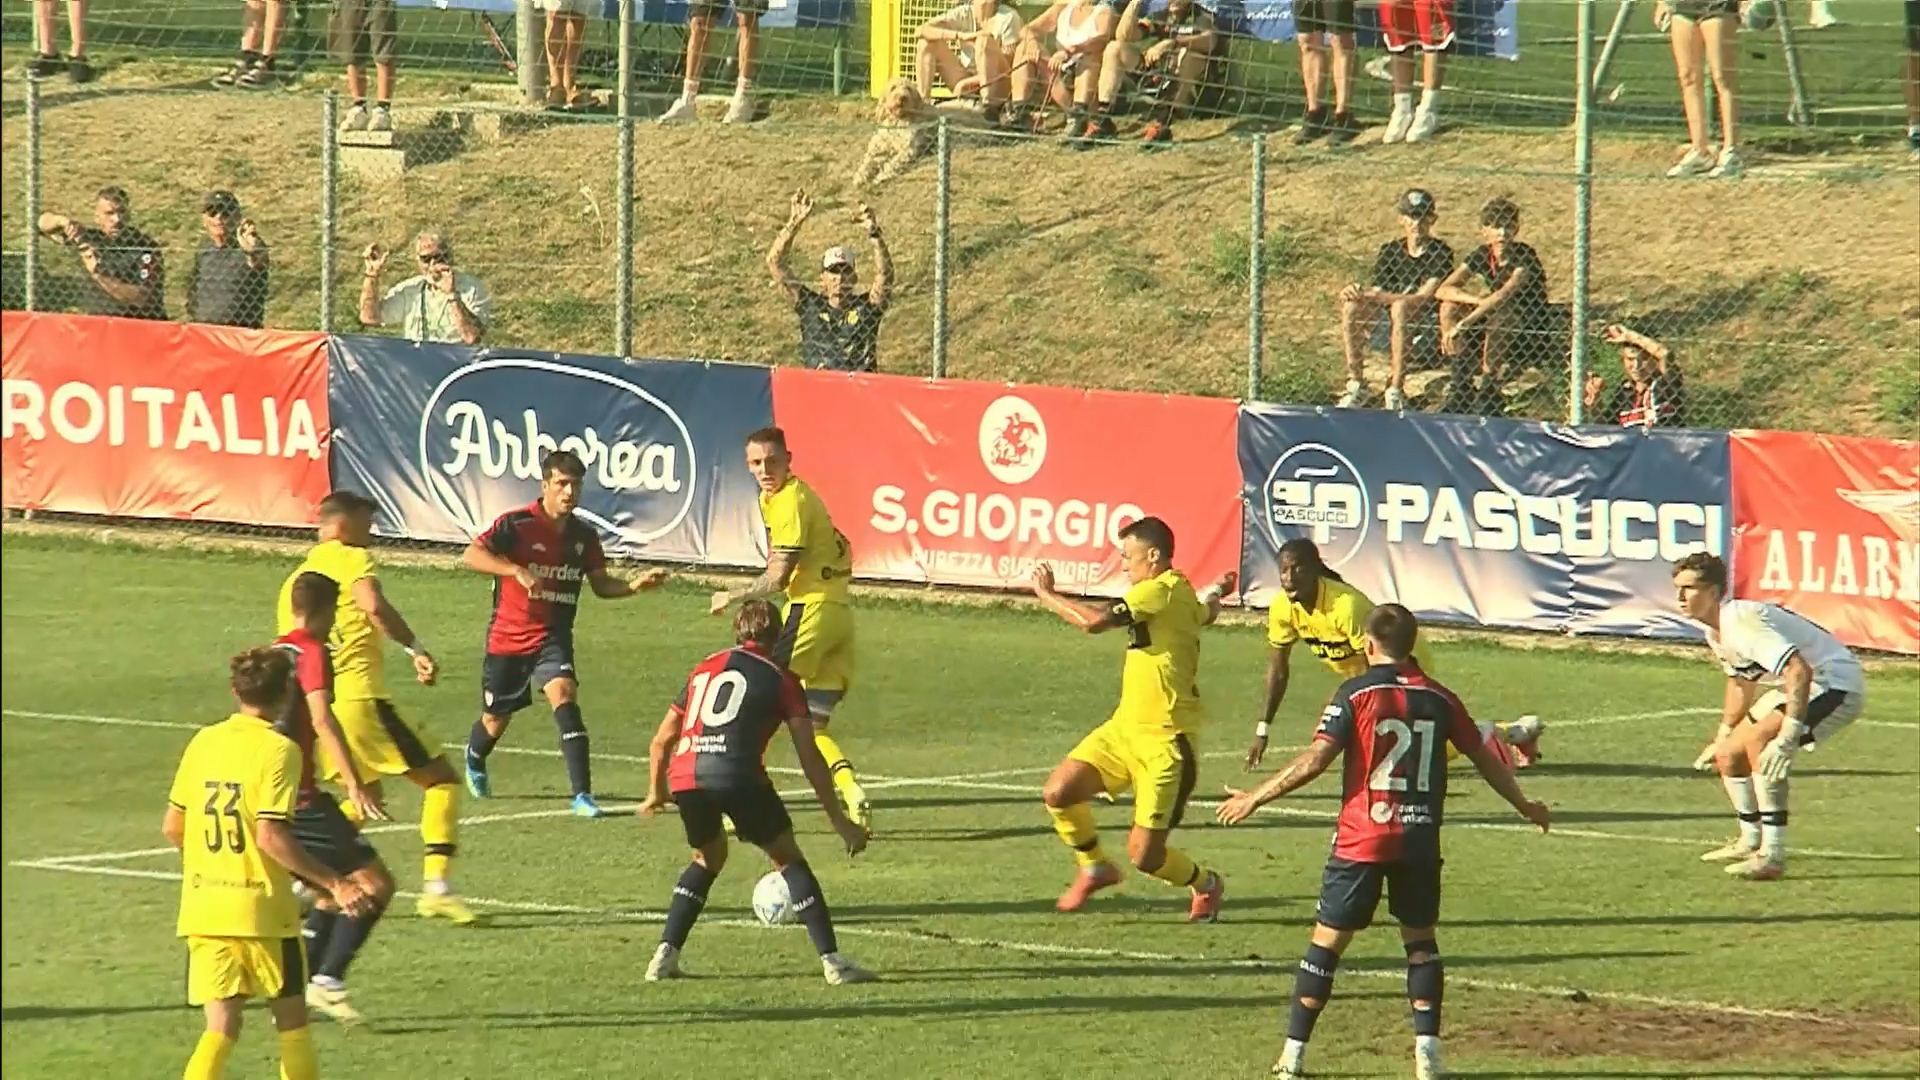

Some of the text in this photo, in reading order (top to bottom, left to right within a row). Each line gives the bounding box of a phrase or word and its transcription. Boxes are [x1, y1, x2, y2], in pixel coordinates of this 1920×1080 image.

[2, 378, 322, 460] ROITALIA
[442, 401, 681, 493] Arborea
[1275, 507, 1350, 524] PASCUCCI
[1377, 482, 1722, 564] PASCUCCI
[998, 556, 1102, 585] SUPRIORE
[686, 669, 748, 728] 10
[1370, 718, 1436, 792] 21
[204, 781, 247, 854] 33
